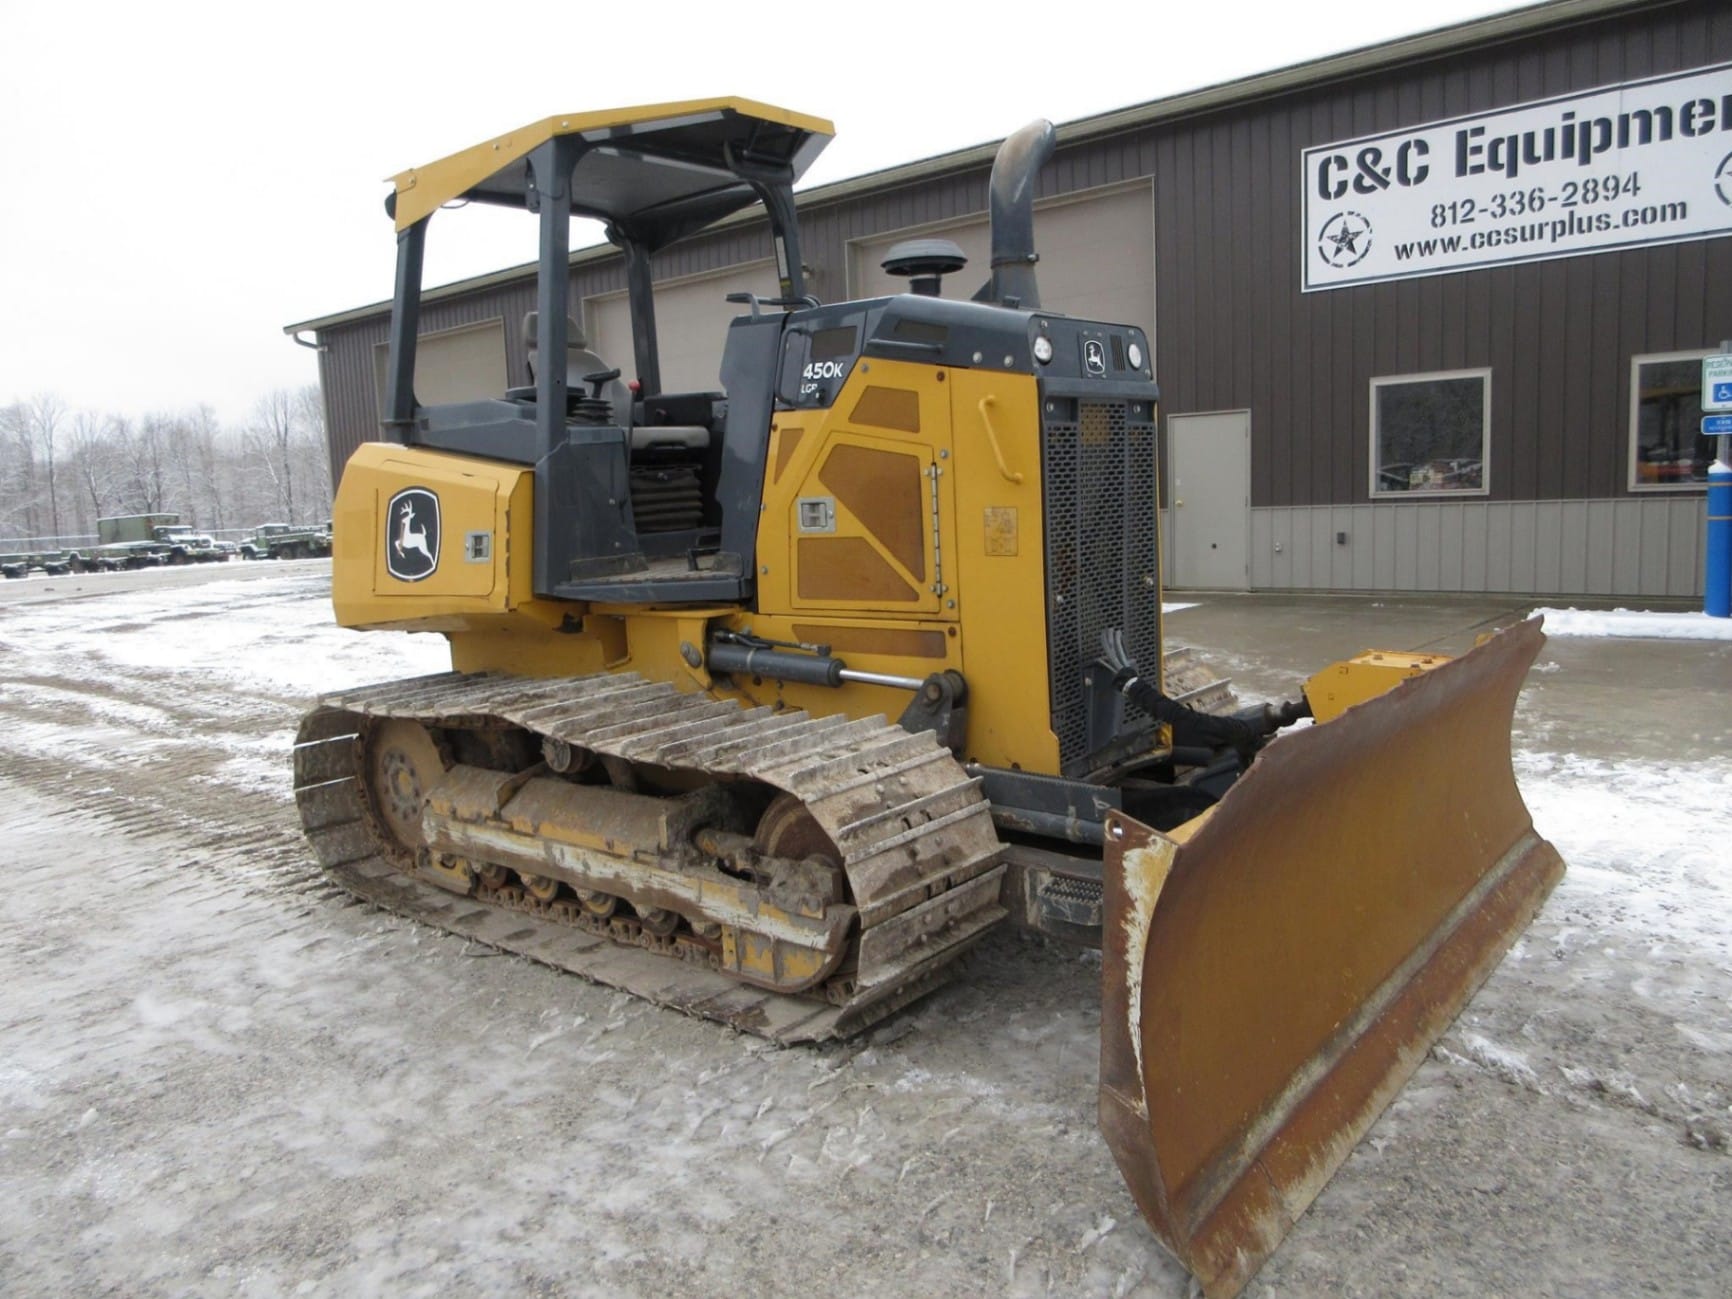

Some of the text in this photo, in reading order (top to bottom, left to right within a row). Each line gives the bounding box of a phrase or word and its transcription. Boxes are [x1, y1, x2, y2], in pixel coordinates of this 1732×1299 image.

[1318, 139, 1429, 200] C&C
[1430, 171, 1641, 228] 812-336-2894
[1394, 200, 1687, 261] www.ccsurplus.com
[803, 361, 843, 379] 450K
